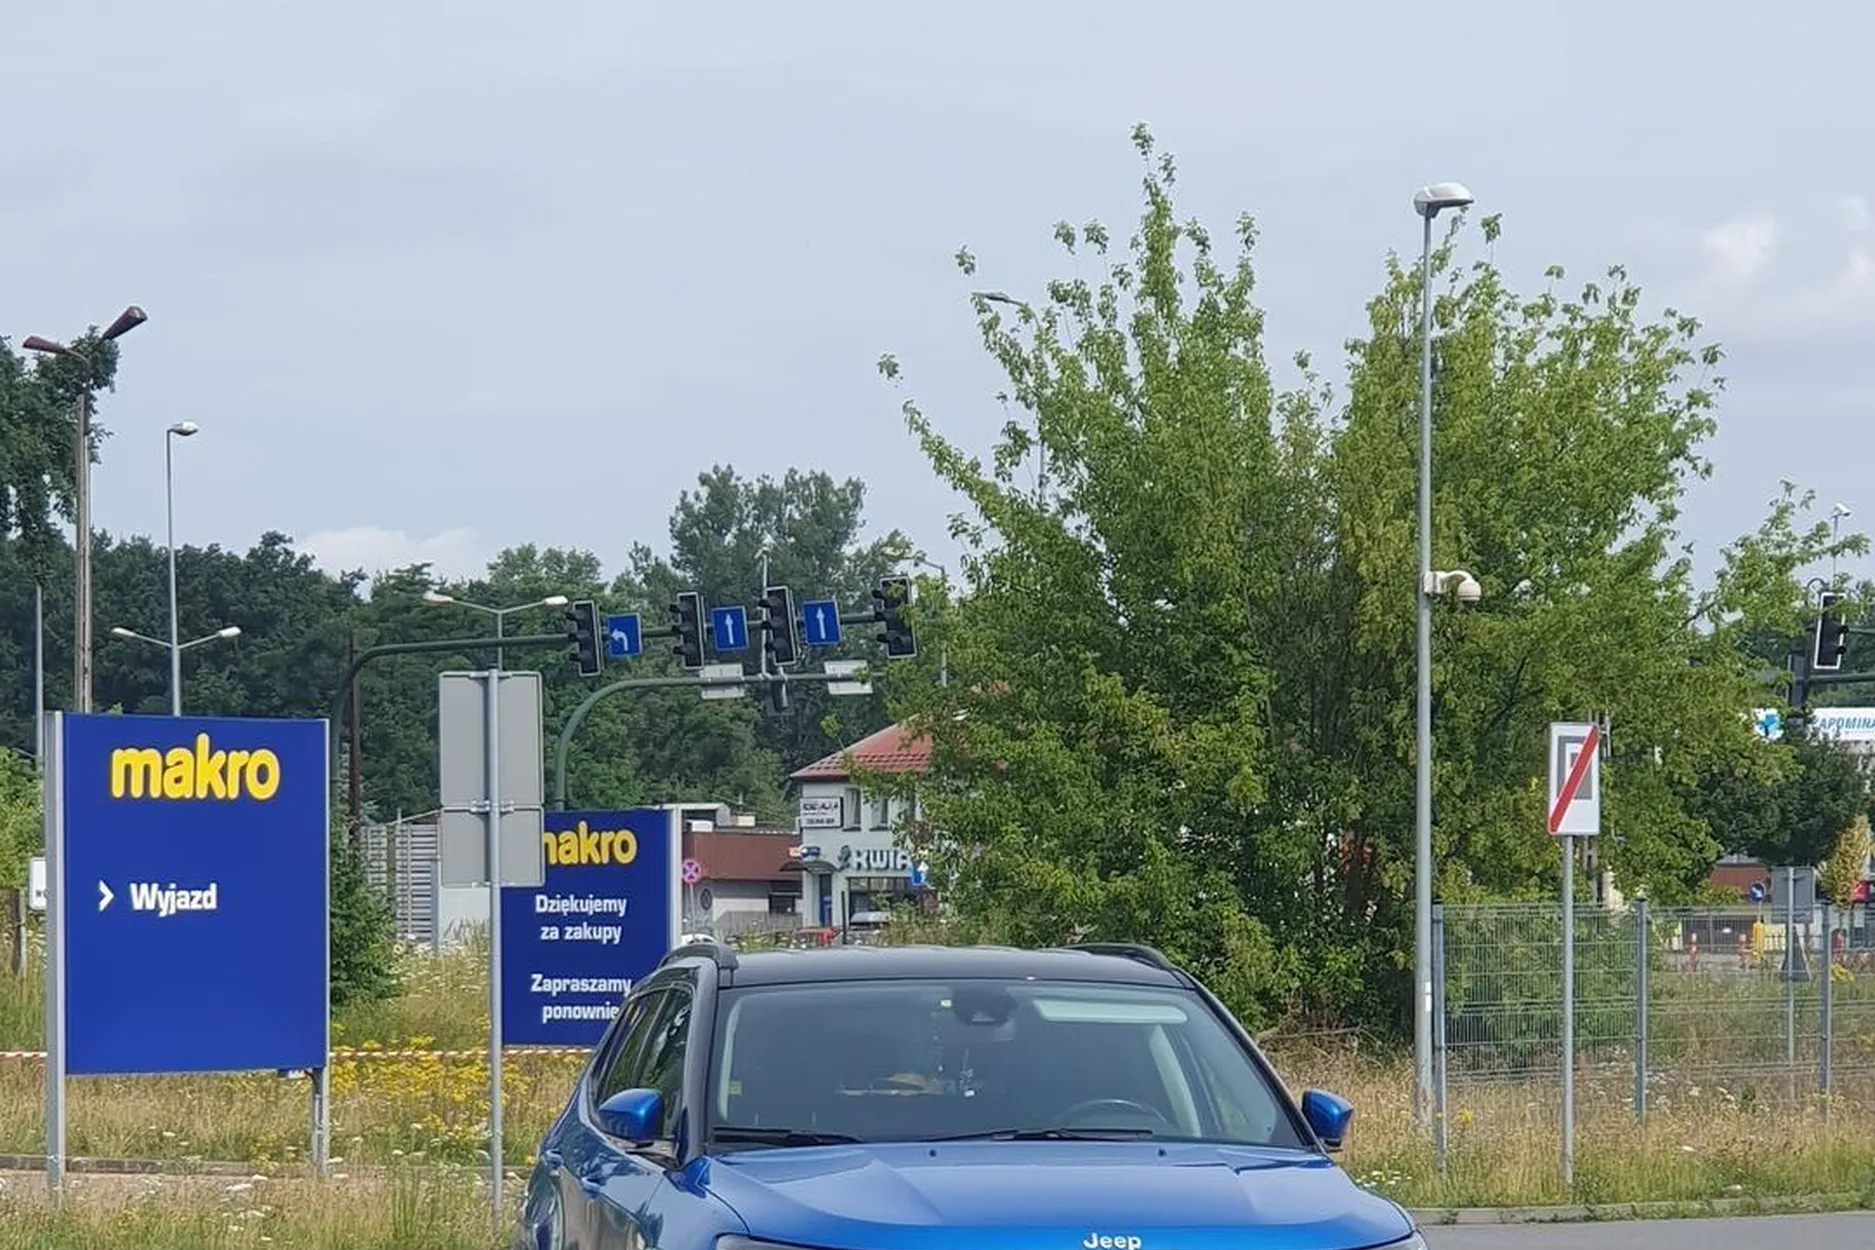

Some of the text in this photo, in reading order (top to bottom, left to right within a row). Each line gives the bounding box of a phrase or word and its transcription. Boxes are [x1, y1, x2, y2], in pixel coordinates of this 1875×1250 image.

[111, 732, 281, 800] makro
[130, 883, 218, 917] Wyjazd
[535, 894, 627, 917] Dziękujemy
[540, 922, 622, 945] za zakupy
[530, 973, 631, 996] Zapraszamy
[542, 1001, 620, 1024] ponownie
[1083, 1232, 1142, 1250] Jeep
